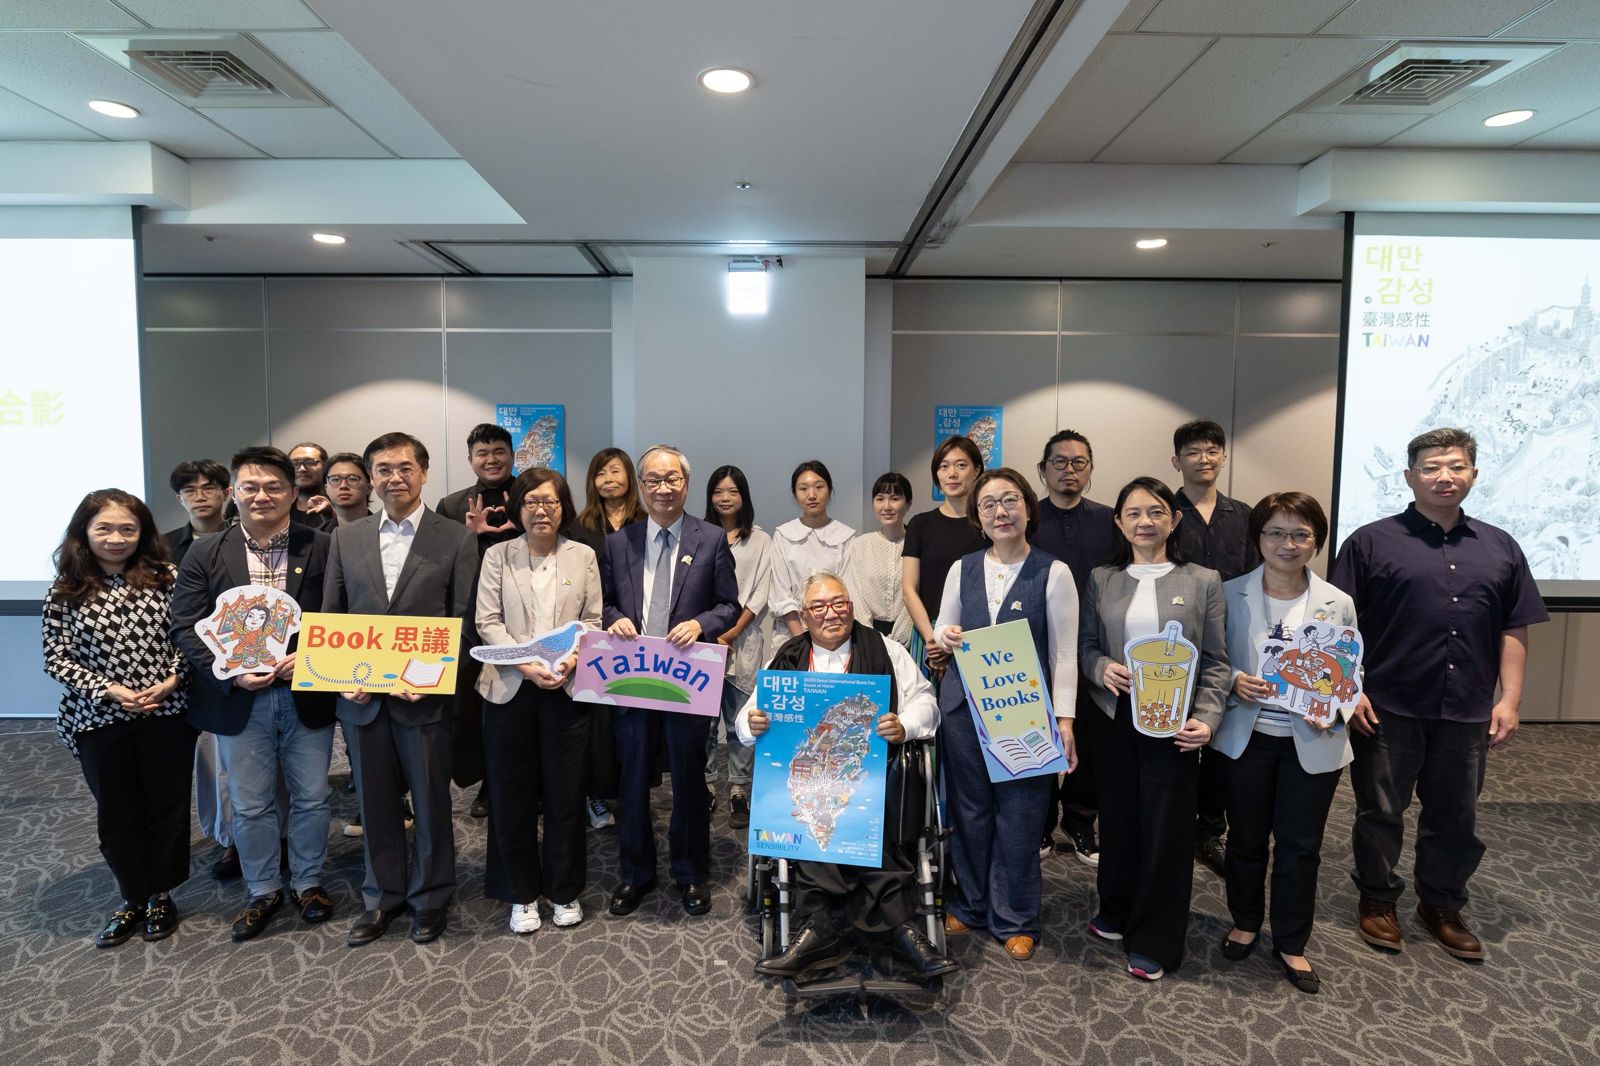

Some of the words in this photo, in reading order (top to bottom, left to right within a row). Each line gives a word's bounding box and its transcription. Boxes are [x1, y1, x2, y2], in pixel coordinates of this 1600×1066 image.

[1366, 244, 1423, 272] 대만
[1377, 277, 1433, 305] 감성
[307, 625, 384, 650] Book
[391, 626, 450, 655] 思議
[586, 646, 711, 692] Taiwan
[980, 650, 1015, 667] We
[763, 676, 799, 693] 대만
[980, 671, 1028, 690] Love
[771, 694, 805, 711] 감성
[980, 690, 1040, 712] Books
